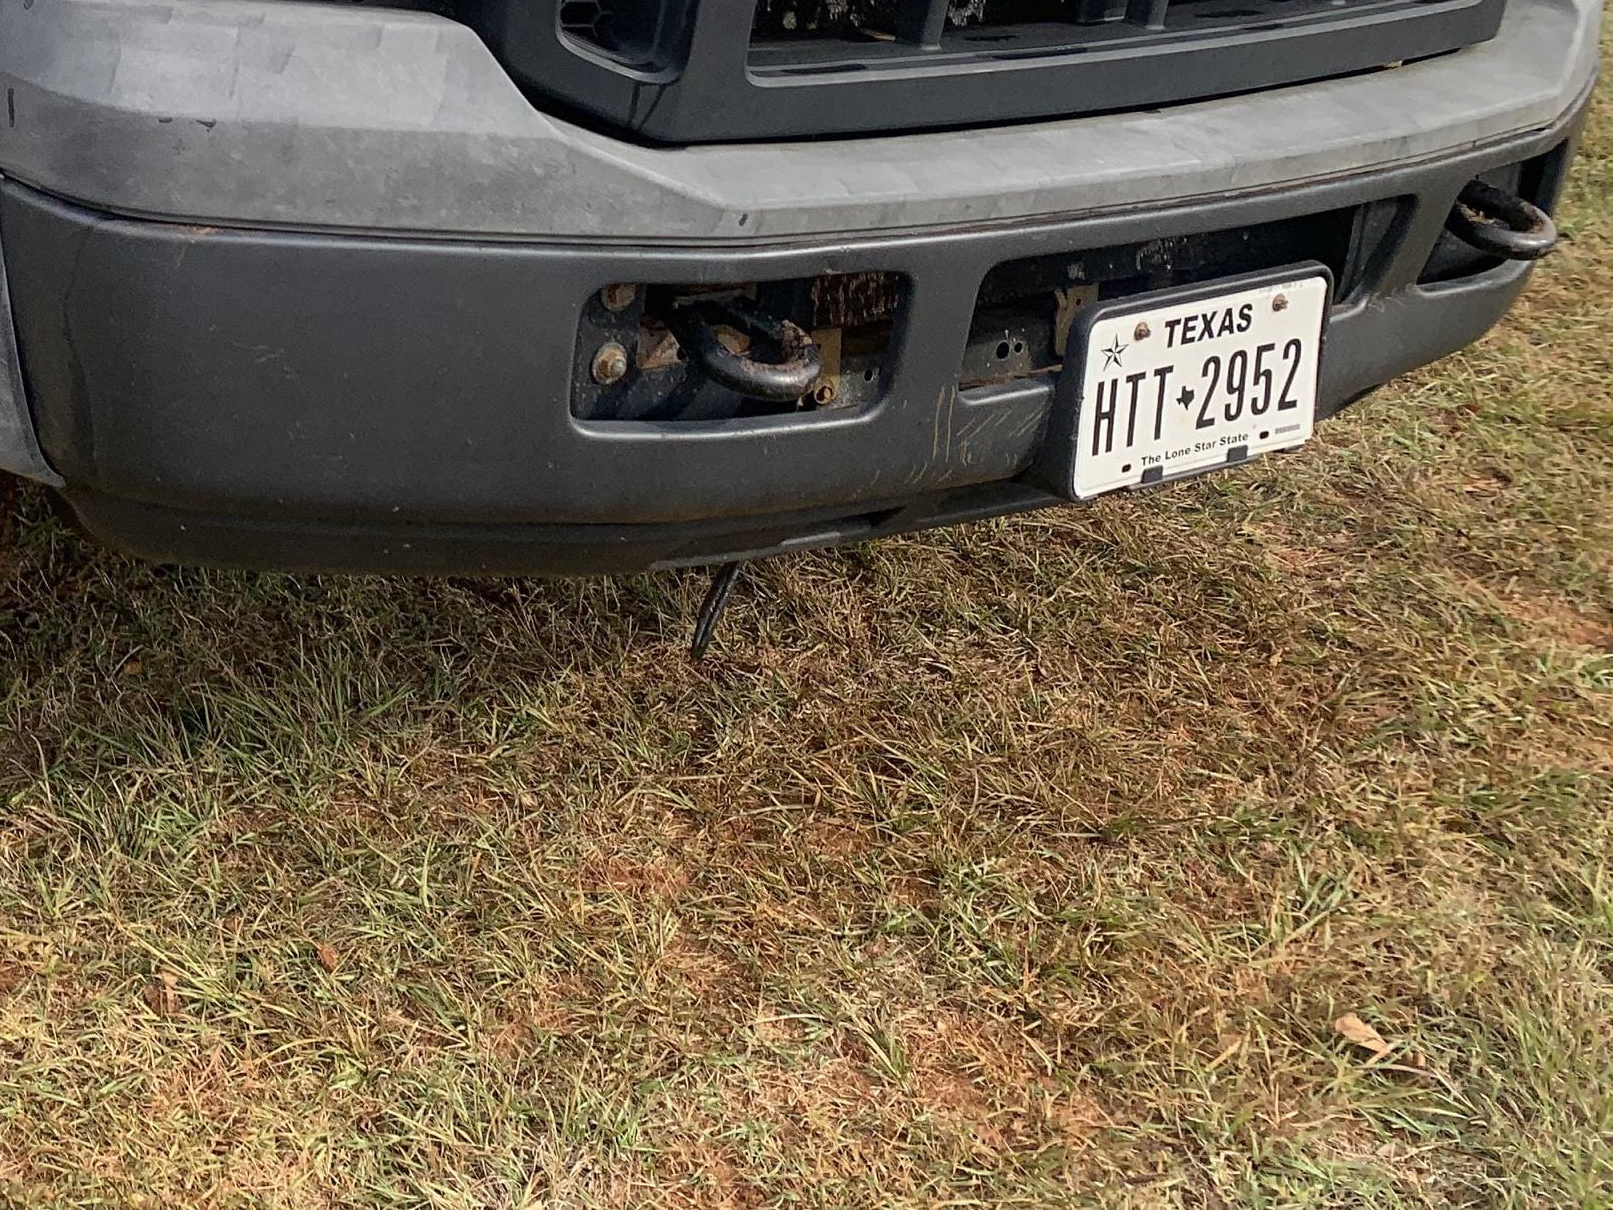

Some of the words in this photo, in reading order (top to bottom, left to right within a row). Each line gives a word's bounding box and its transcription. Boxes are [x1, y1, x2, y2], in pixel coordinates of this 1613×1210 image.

[1164, 303, 1253, 348] TEXAS
[1092, 365, 1174, 456] HTT
[1196, 338, 1302, 430] 2952
[1141, 454, 1161, 466] The
[1165, 447, 1191, 460] Lone
[1194, 440, 1216, 452] Star
[1219, 432, 1249, 446] State
